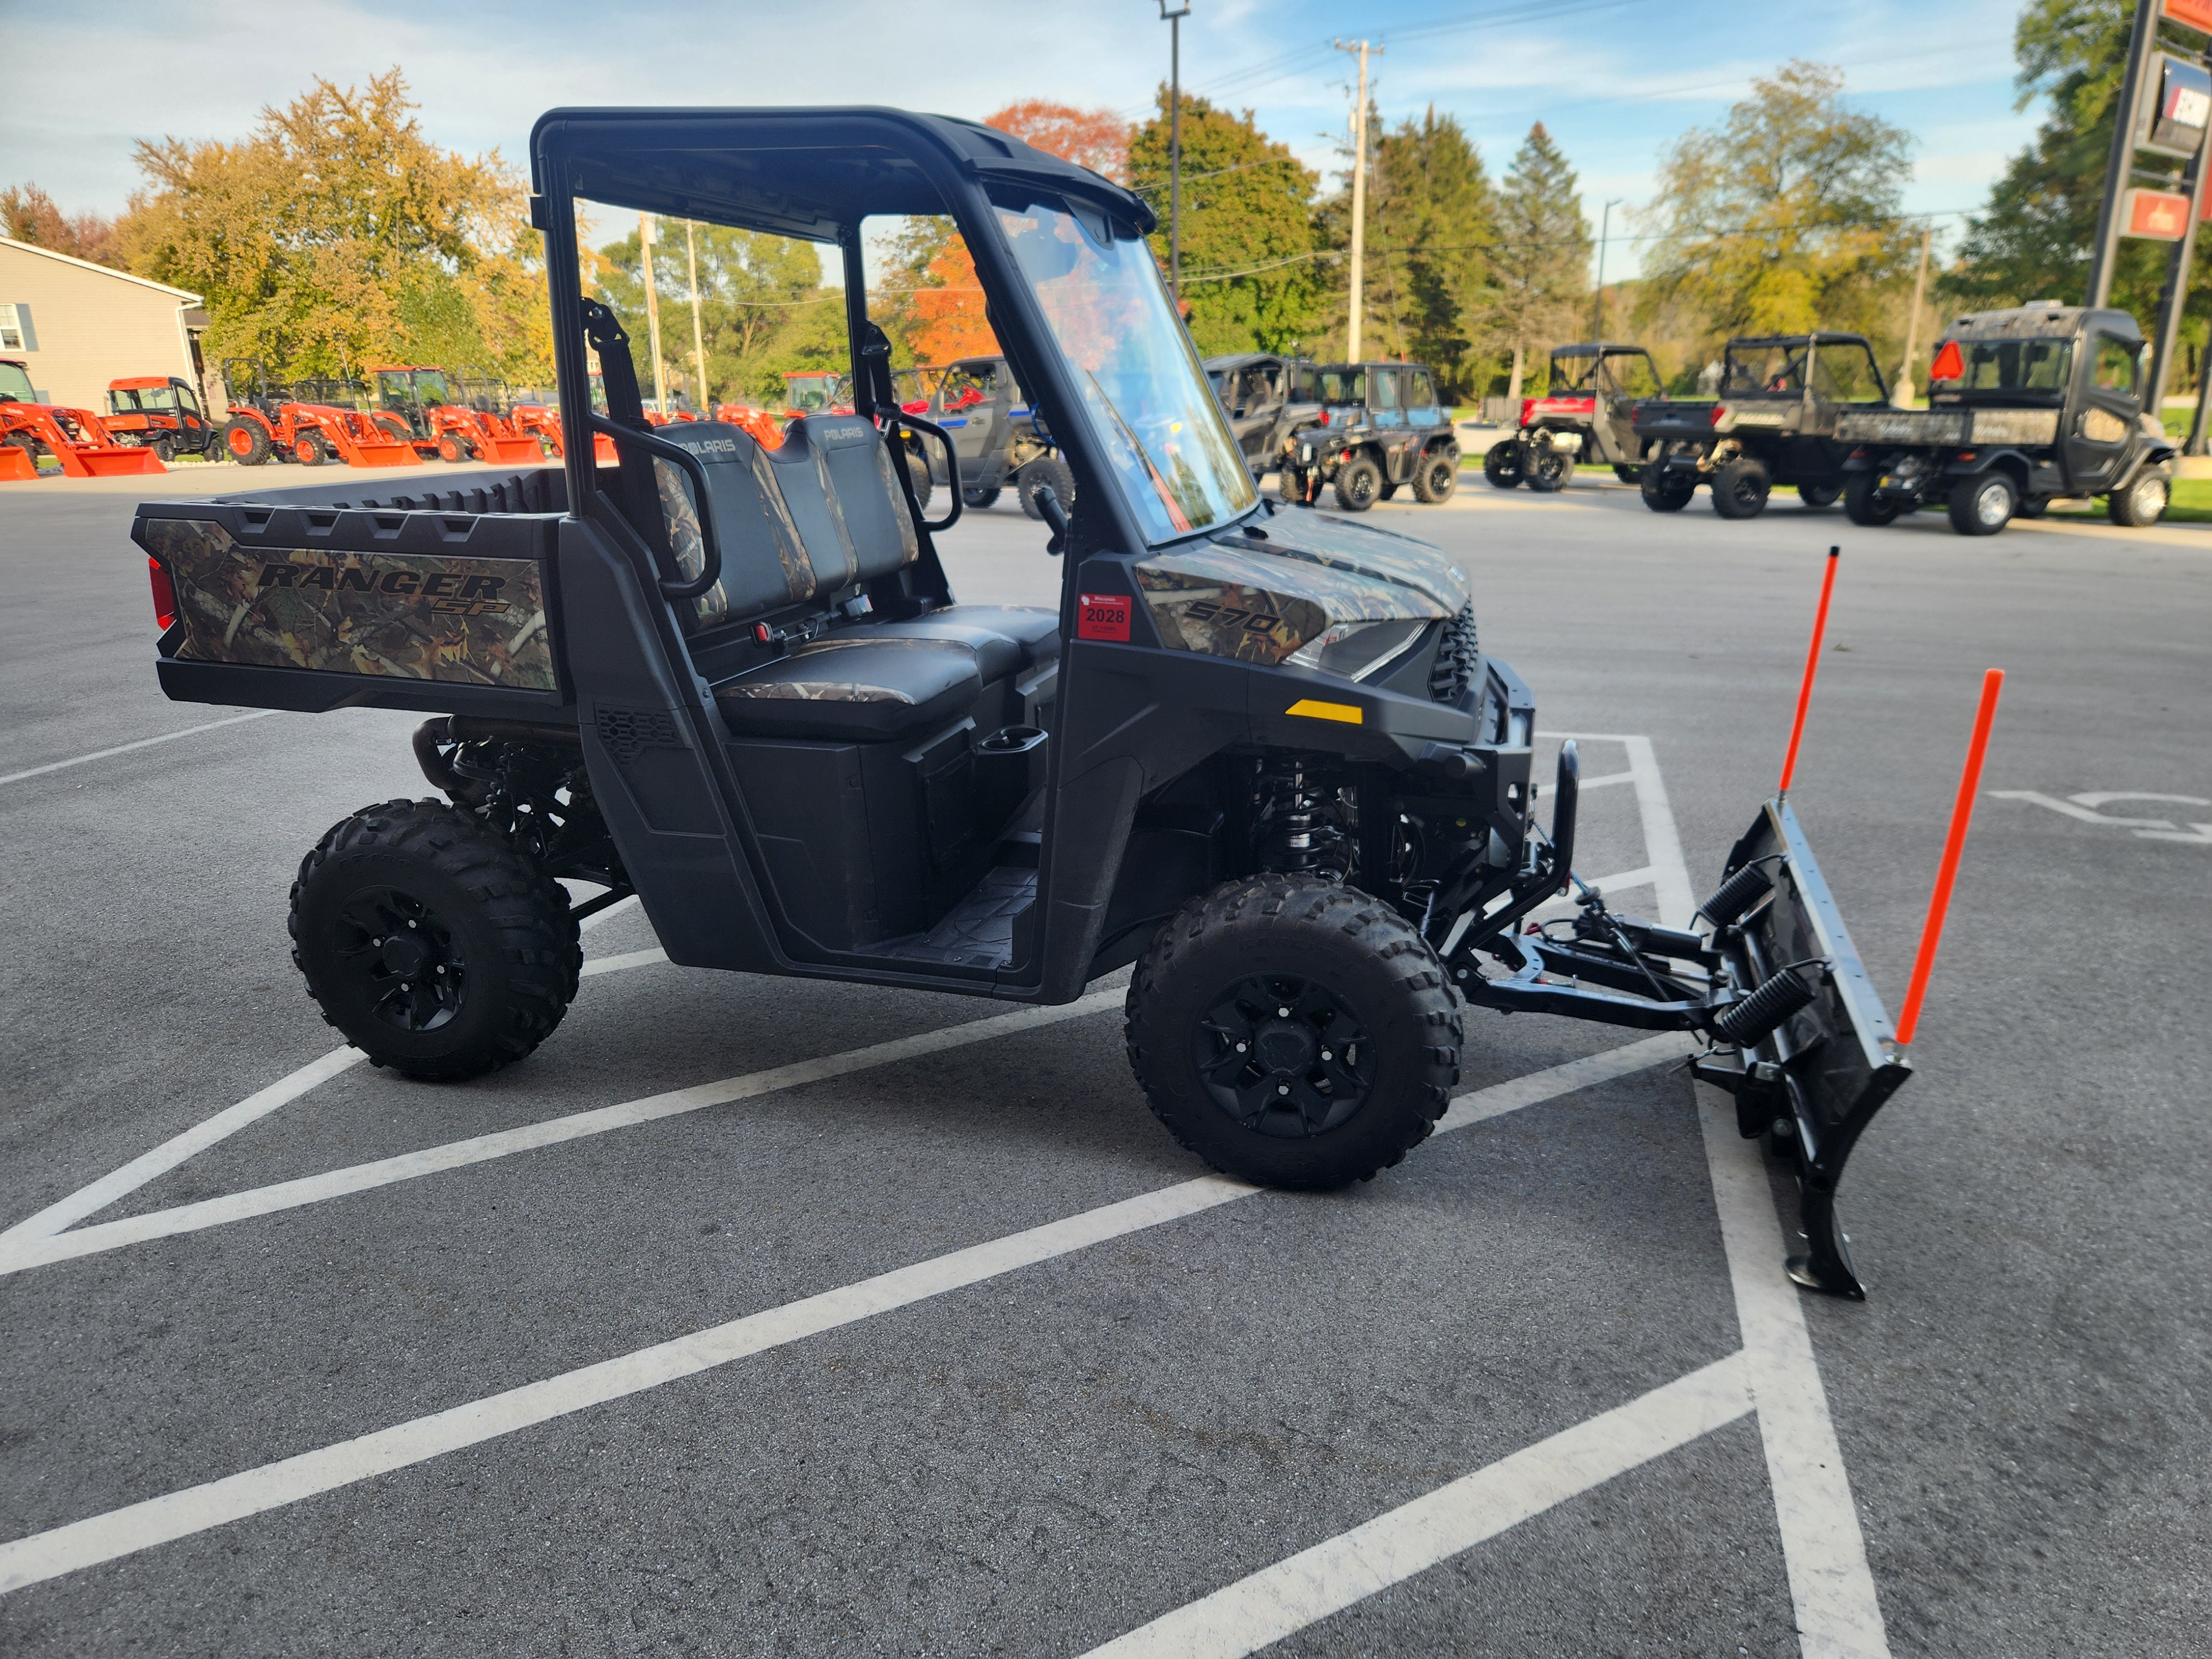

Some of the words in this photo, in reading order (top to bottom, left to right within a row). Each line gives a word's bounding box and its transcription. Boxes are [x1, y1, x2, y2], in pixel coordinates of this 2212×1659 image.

[824, 427, 864, 441] POLARIS
[679, 439, 736, 455] POLARIS
[258, 563, 507, 600] RANGER
[429, 599, 512, 616] SP
[1086, 608, 1124, 623] 2028
[1182, 600, 1281, 634] 570
